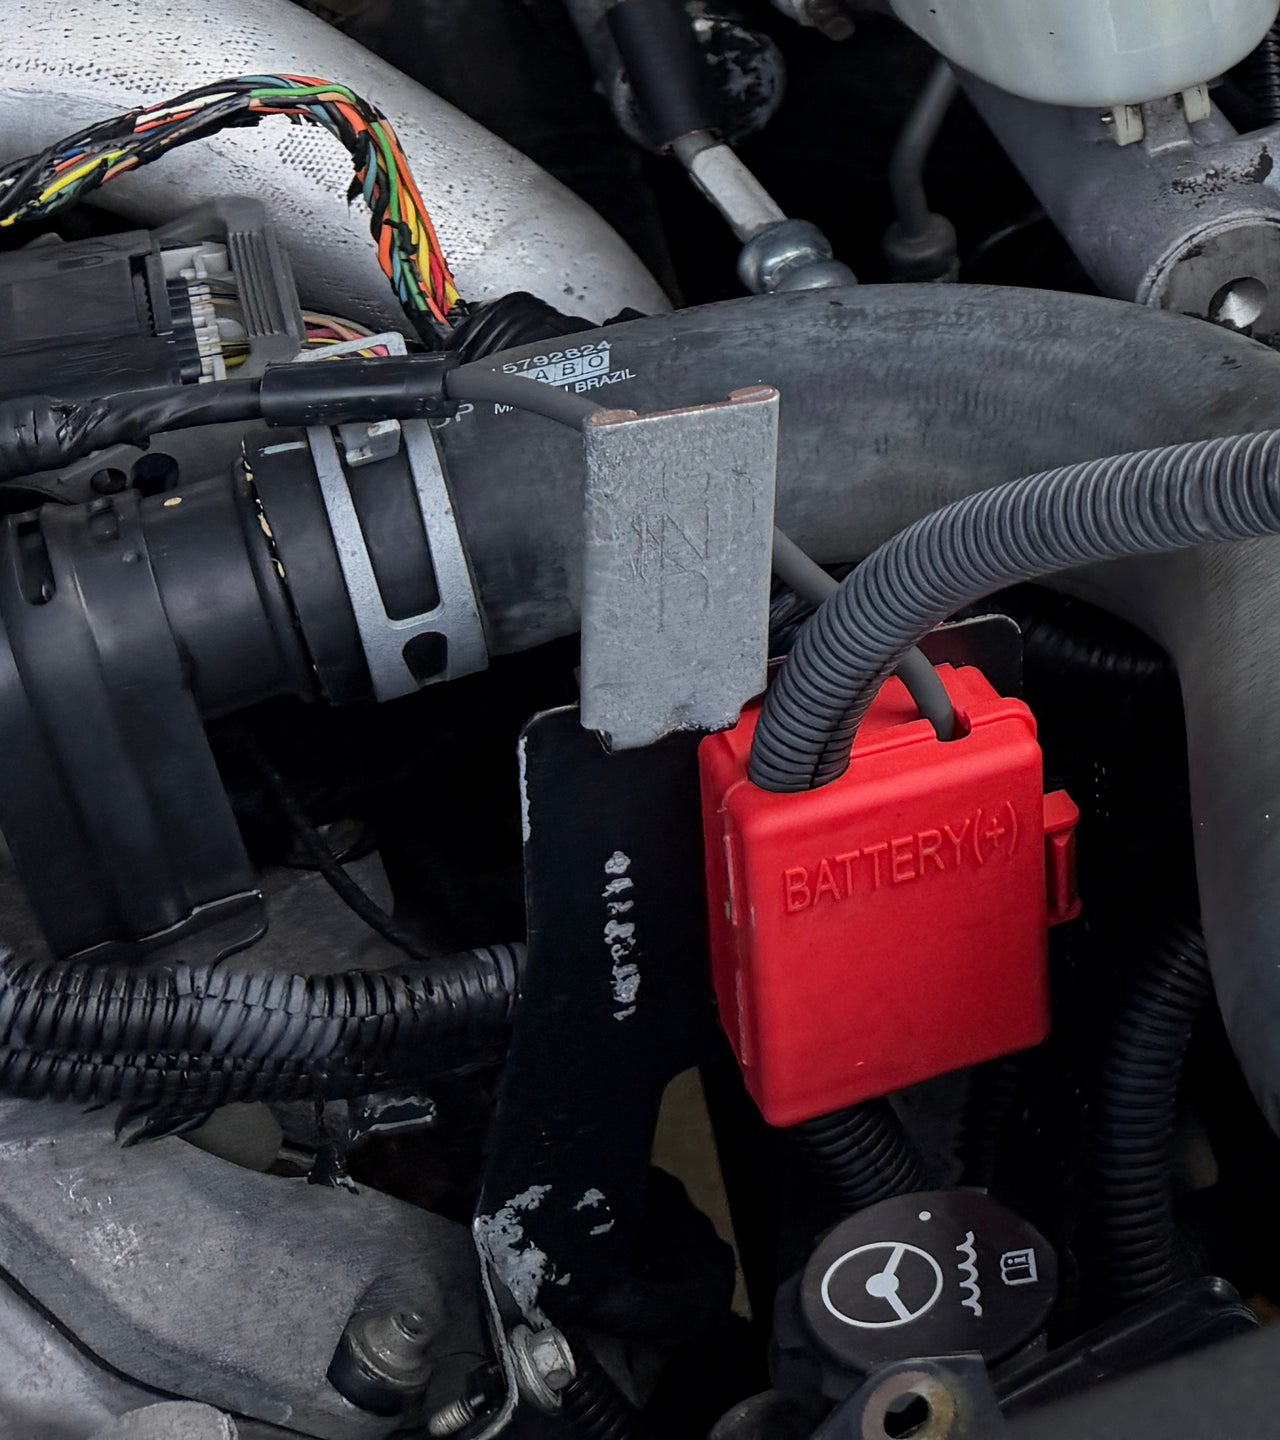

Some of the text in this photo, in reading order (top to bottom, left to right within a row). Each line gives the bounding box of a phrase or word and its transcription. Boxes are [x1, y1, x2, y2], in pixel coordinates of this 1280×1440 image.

[492, 340, 612, 374] 5792824
[575, 368, 636, 393] BRAZIL
[783, 800, 1019, 913] BATTERY(+)
